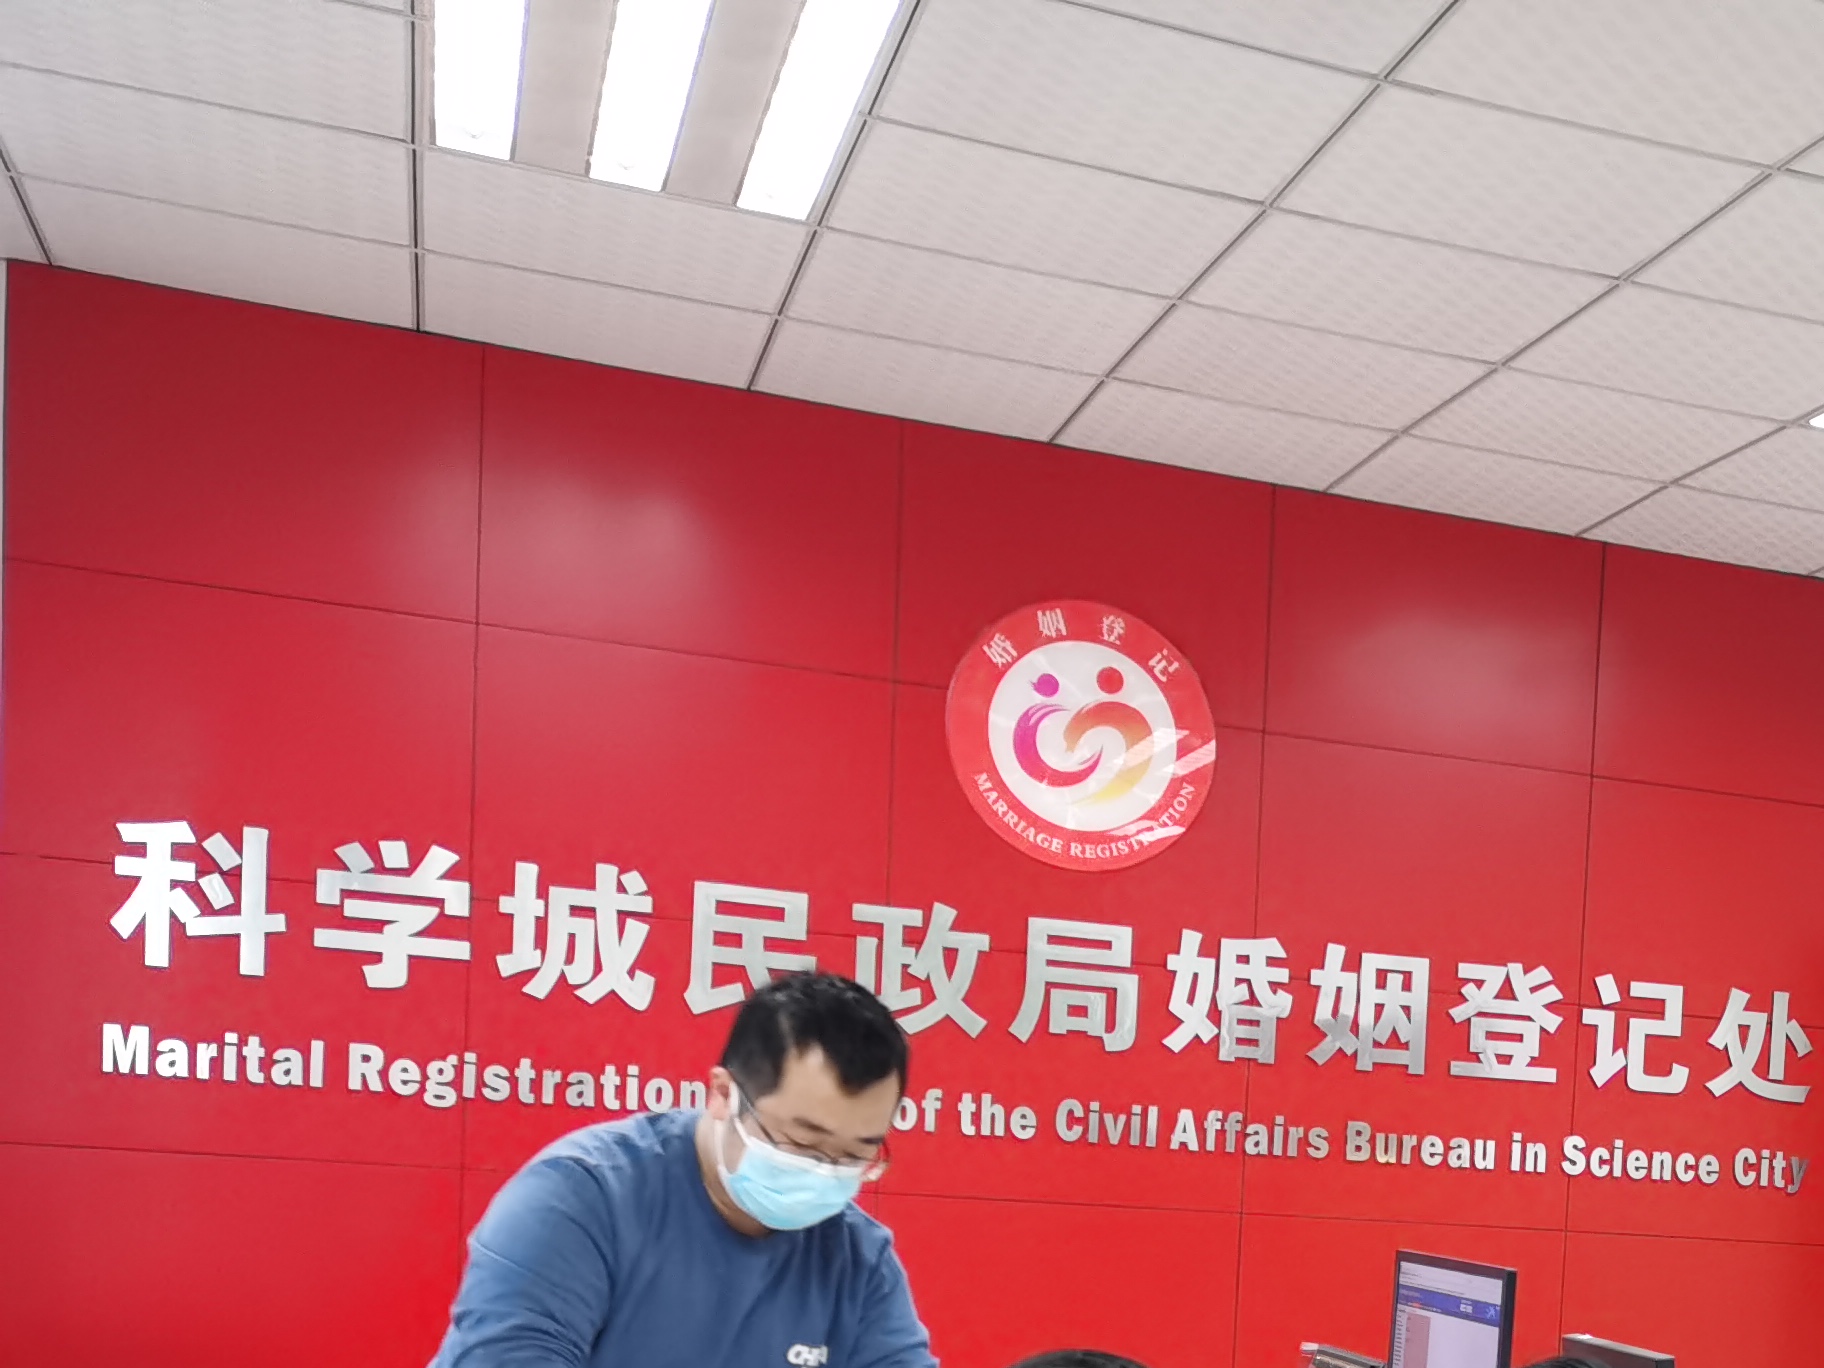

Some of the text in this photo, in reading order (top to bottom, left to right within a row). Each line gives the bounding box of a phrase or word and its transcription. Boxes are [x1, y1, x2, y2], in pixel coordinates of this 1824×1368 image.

[981, 607, 1180, 683] 婚姻登记
[974, 771, 1064, 854] MARRIAGE
[109, 820, 1813, 1103] 科学城民政局婚姻登记处
[101, 1022, 1810, 1195] Marital Registration of the Civil Affairs Bureau in Science City
